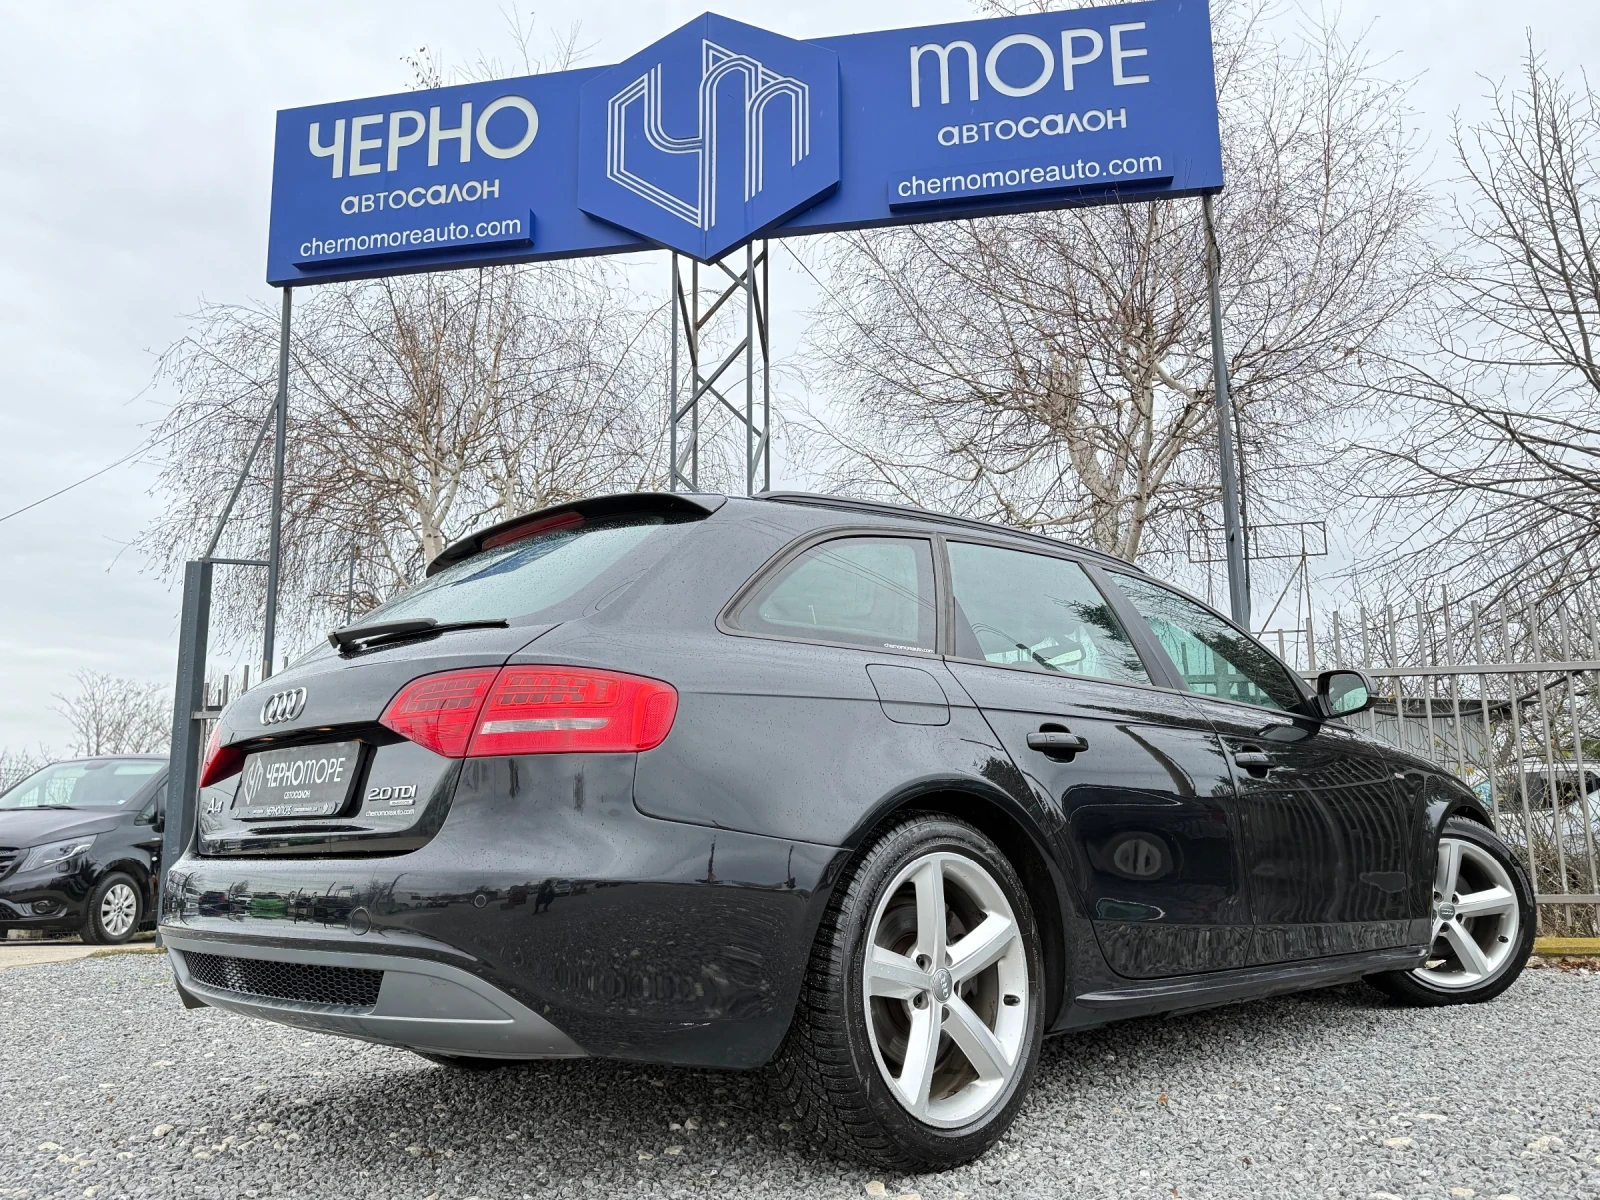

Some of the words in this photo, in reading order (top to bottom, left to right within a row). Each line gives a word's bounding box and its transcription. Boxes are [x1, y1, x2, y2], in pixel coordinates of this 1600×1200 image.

[309, 94, 539, 179] ЧЕРНО
[898, 155, 1162, 197] chernomoreauto.com
[299, 216, 521, 257] chernomoreauto.com
[207, 797, 223, 813] A4
[393, 785, 416, 798] TDI
